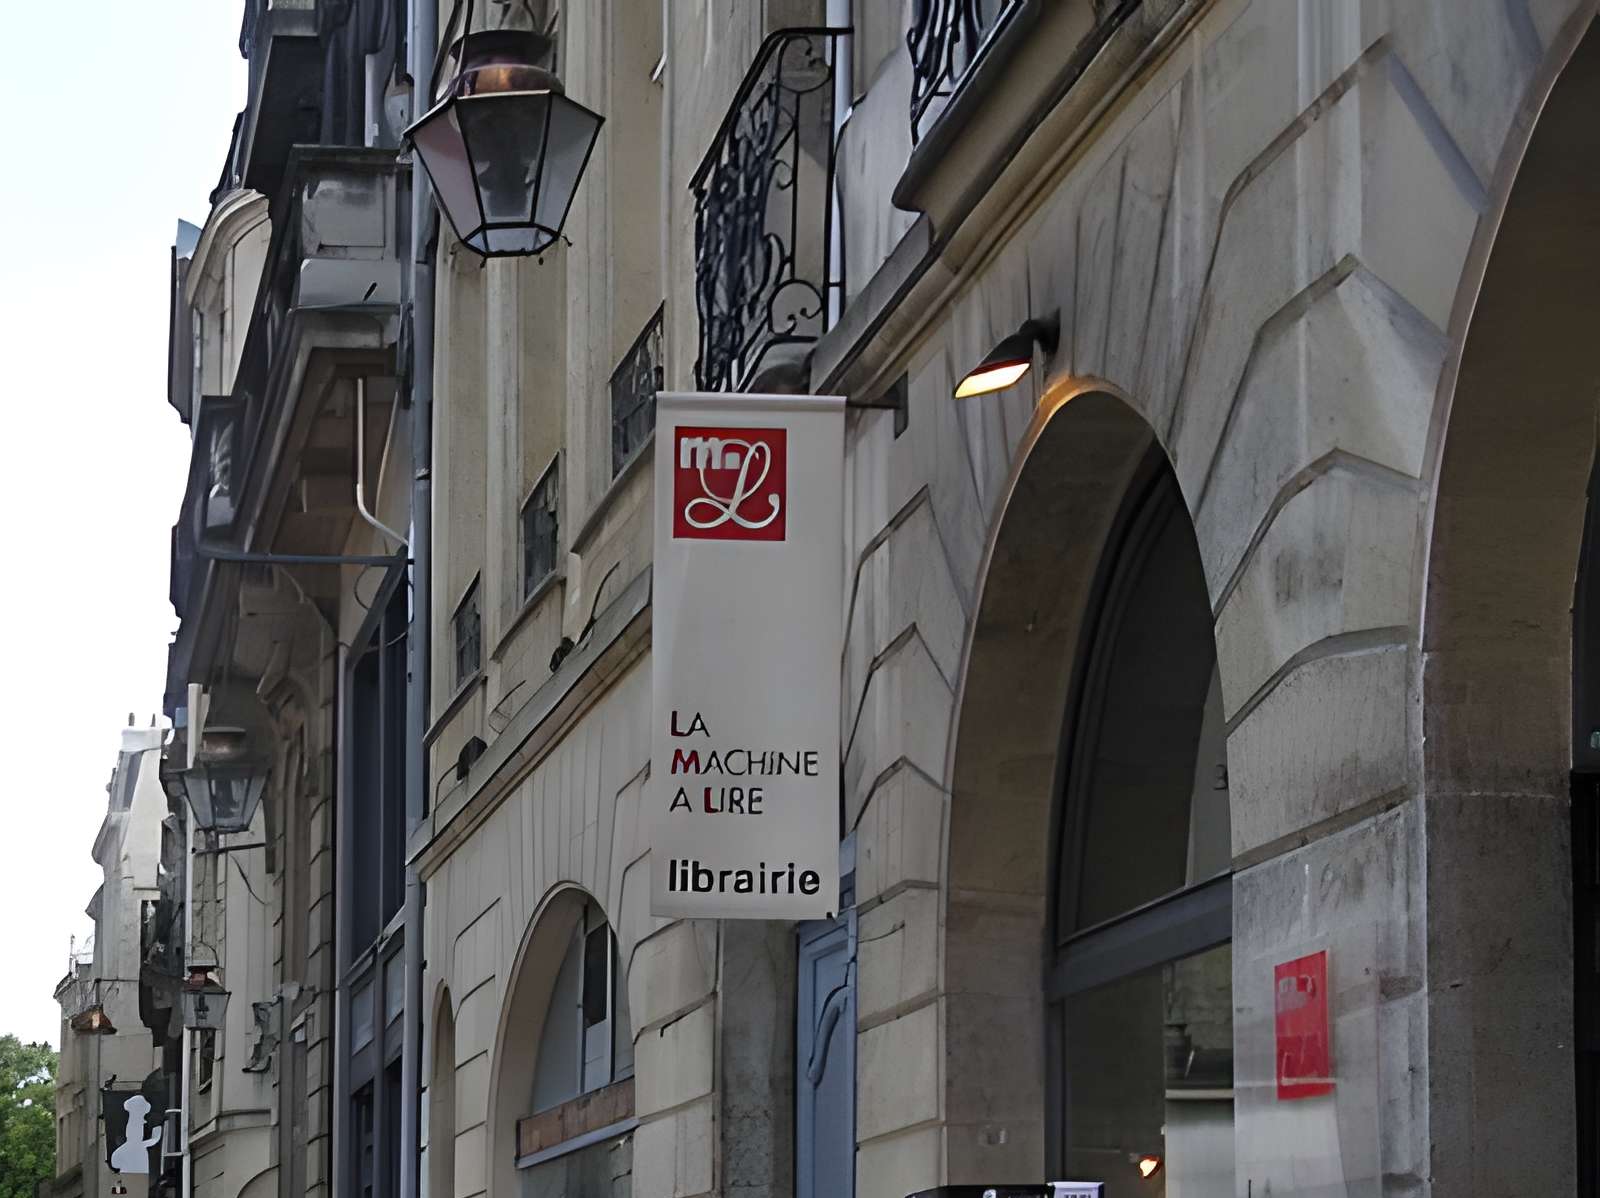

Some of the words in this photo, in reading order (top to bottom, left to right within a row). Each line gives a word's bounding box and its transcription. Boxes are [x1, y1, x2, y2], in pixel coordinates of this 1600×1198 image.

[670, 710, 711, 738] LA
[670, 748, 819, 777] MACHINE
[703, 786, 764, 815] LIRE
[668, 859, 821, 896] librairie
